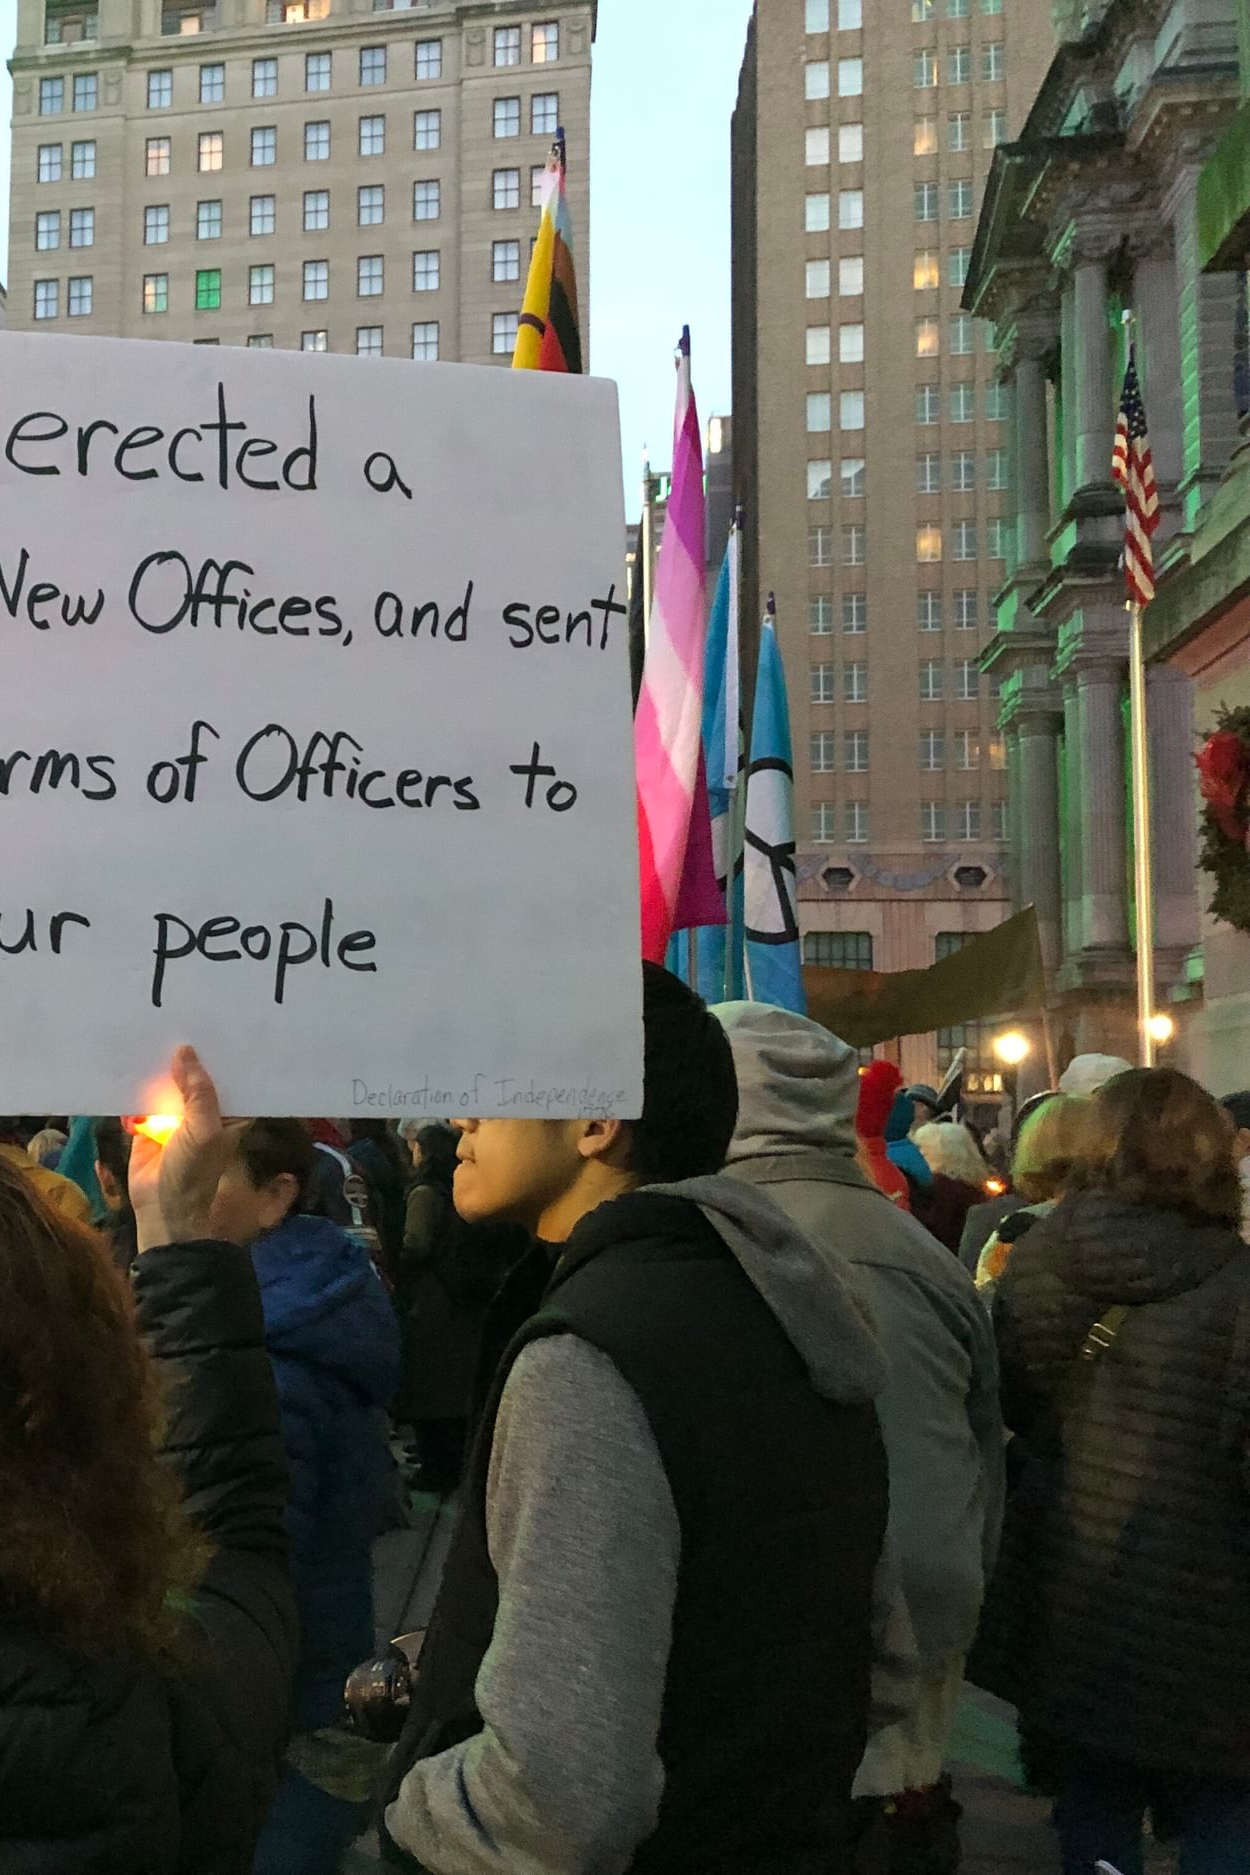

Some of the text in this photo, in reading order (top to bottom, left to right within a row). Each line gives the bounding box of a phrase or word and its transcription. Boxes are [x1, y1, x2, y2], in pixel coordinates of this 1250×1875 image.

[5, 382, 317, 491] erected
[364, 451, 412, 499] a
[129, 551, 352, 646] Offices,
[375, 580, 473, 642] and
[503, 584, 626, 650] sent
[147, 721, 220, 803] of
[236, 724, 480, 811] Officers
[510, 742, 578, 812] to
[152, 898, 378, 1007] people
[352, 1072, 626, 1110] Declaration of Independence
